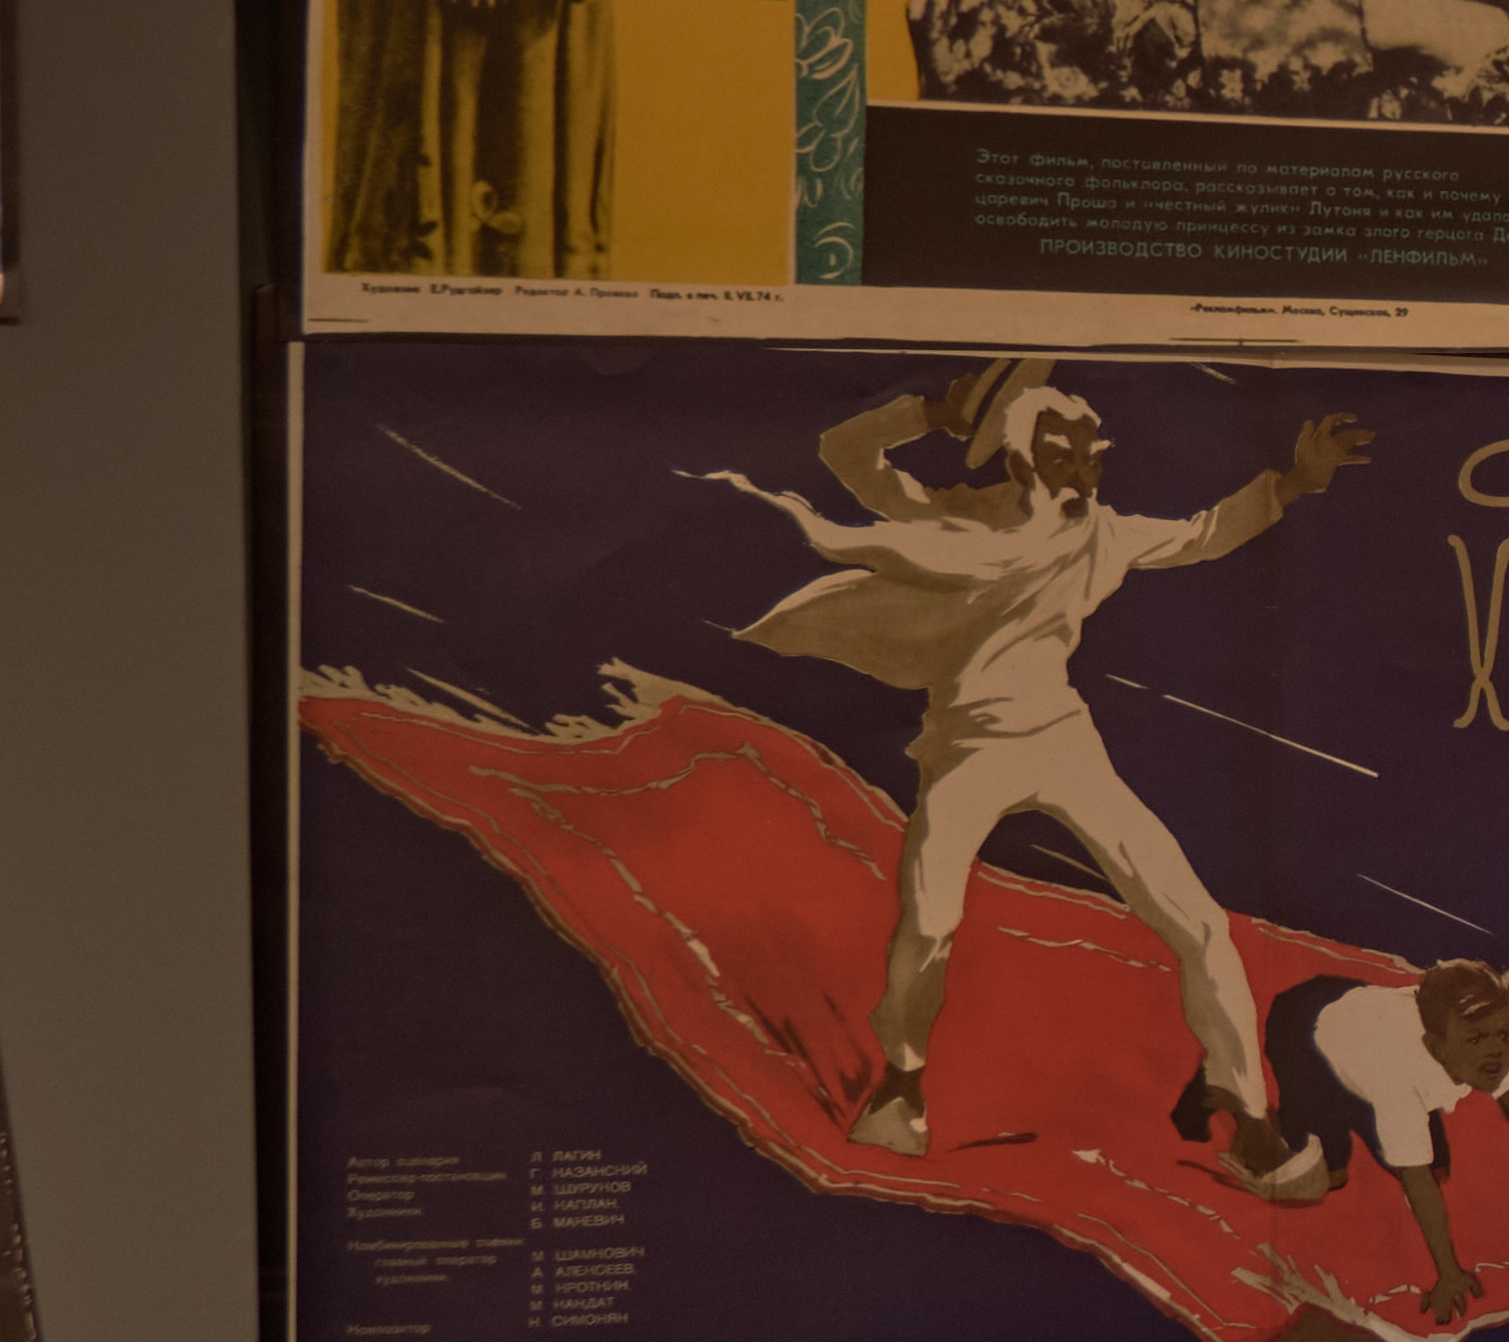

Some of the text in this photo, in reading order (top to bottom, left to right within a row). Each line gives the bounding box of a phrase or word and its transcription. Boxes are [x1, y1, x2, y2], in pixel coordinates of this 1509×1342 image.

[976, 148, 1459, 182] Этот фильм, поставленный по материалам русского
[1040, 239, 1202, 258] ПРОИЗВОДСТВО
[1214, 245, 1347, 264] КИНОСТУДИИ
